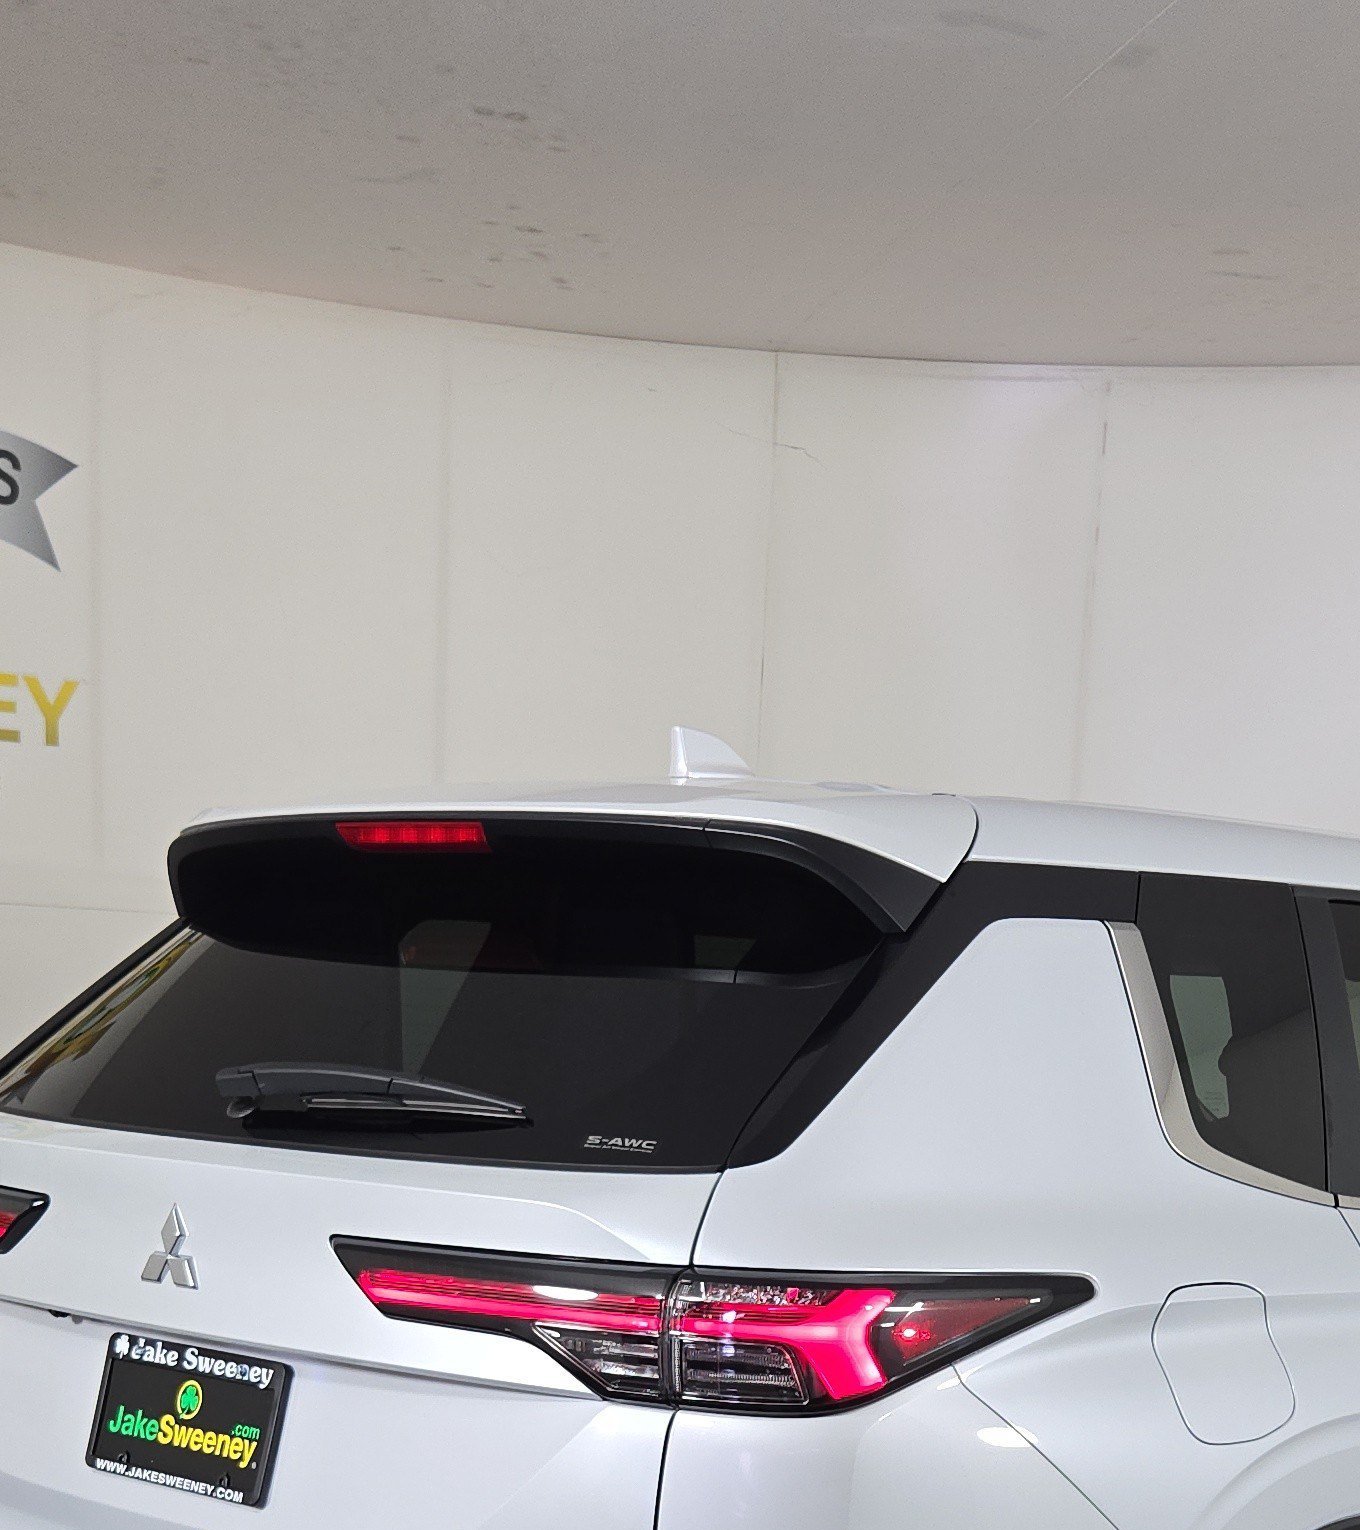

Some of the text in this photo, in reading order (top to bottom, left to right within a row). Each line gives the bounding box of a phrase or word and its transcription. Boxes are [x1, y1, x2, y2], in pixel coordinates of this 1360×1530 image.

[586, 1135, 658, 1150] S-AWC
[183, 1347, 275, 1390] Sweeney
[95, 1457, 244, 1503] WWW.JAKESWEENEY.COM
